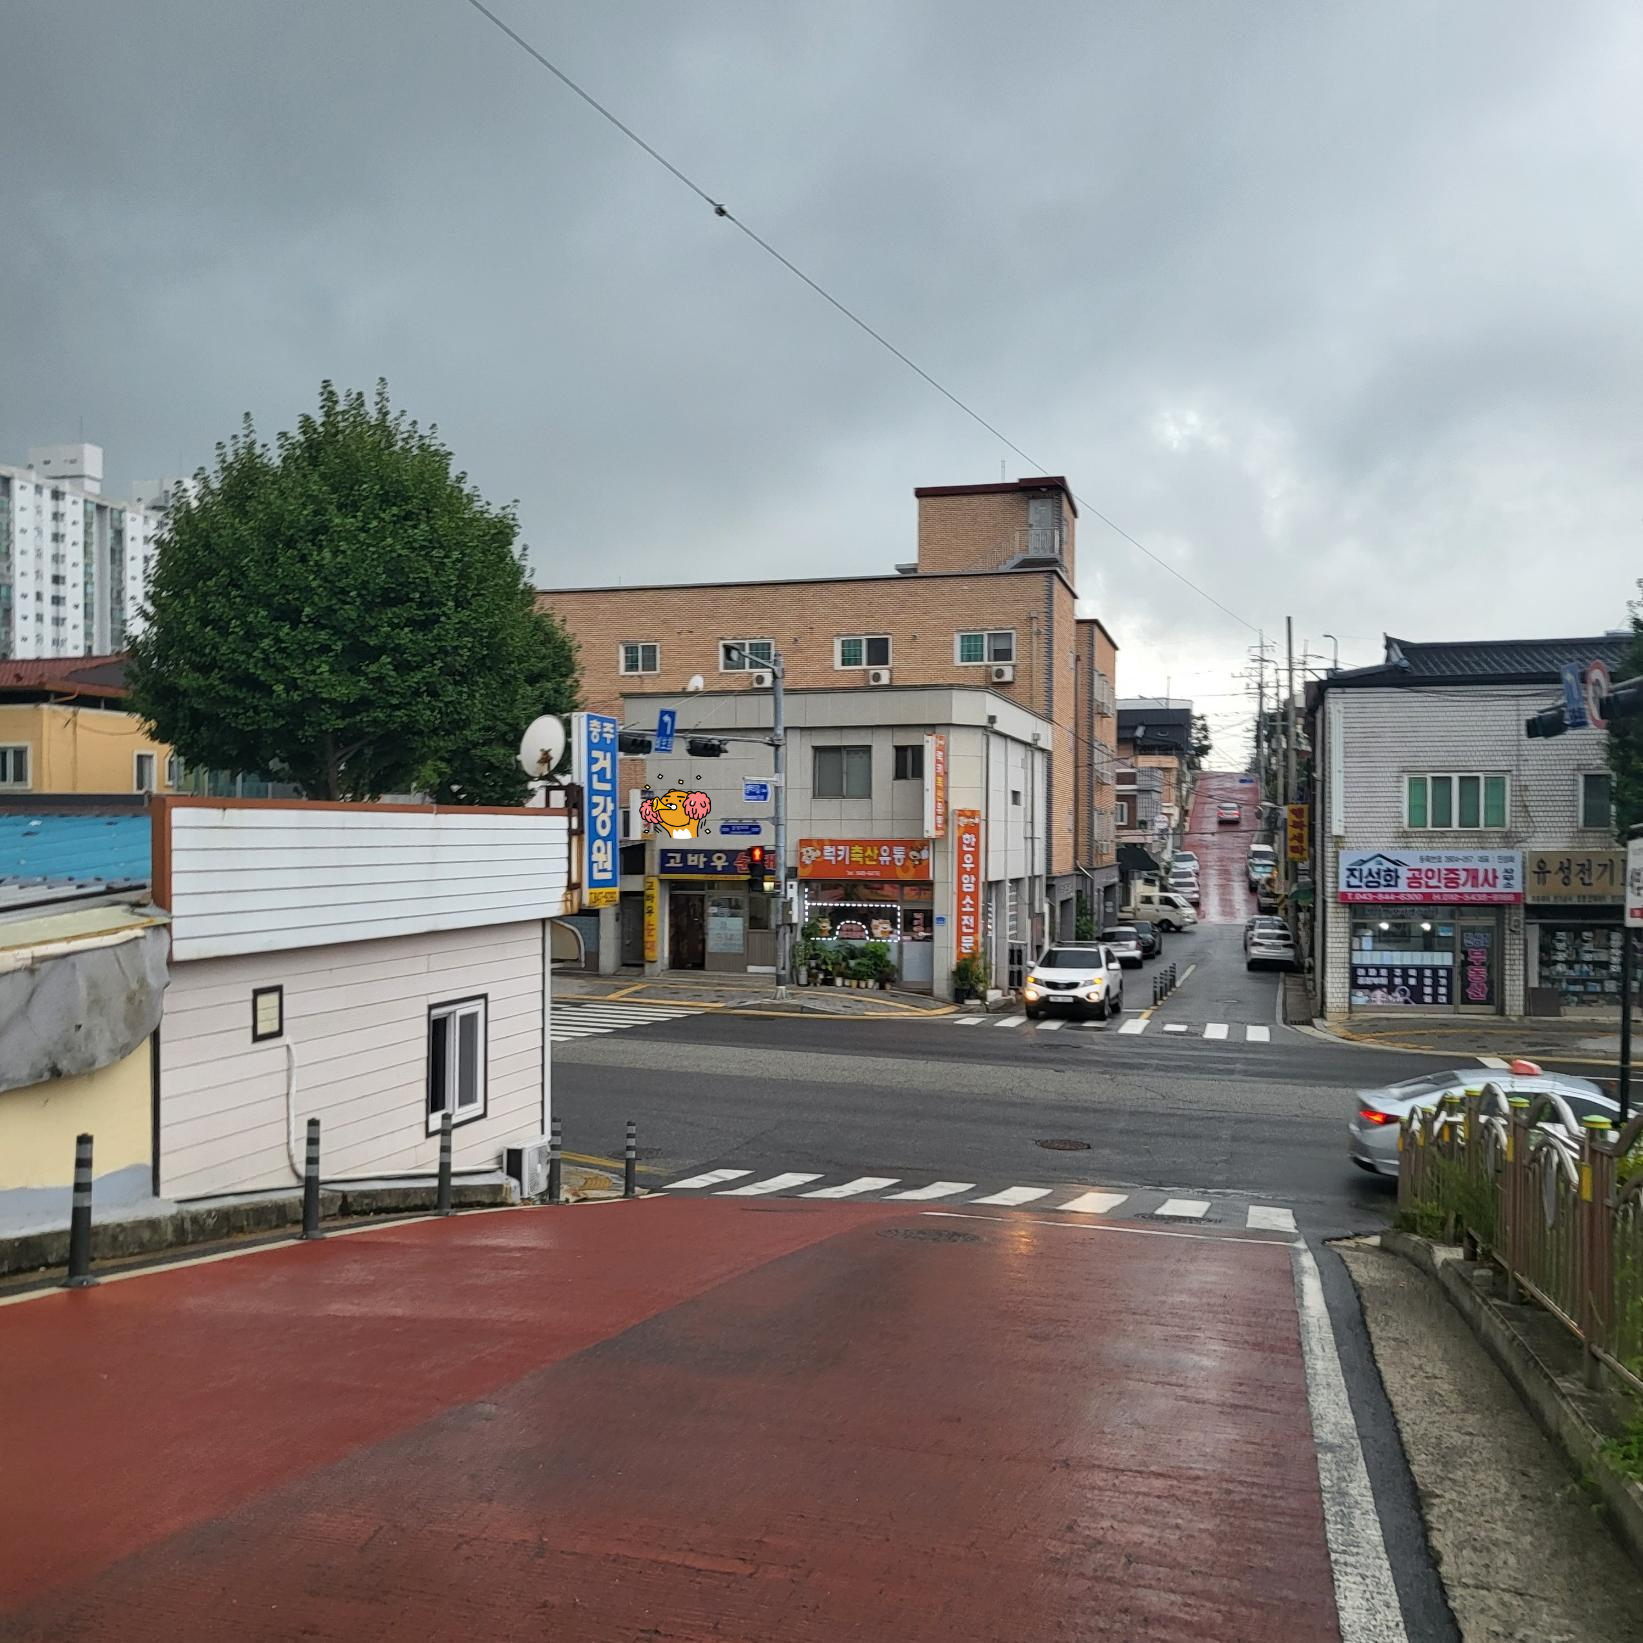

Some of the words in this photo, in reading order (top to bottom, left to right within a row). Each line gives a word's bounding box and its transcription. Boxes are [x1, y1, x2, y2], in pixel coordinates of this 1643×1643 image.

[589, 719, 616, 745] 충주
[590, 750, 614, 880] 건강원
[665, 852, 729, 871] 고바우
[823, 845, 906, 866] 럭키축산유통
[1345, 867, 1400, 889] 진성화
[1406, 867, 1499, 889] 공인중개사
[960, 832, 976, 955] 한우암소전문
[1466, 949, 1488, 1000] 부동산
